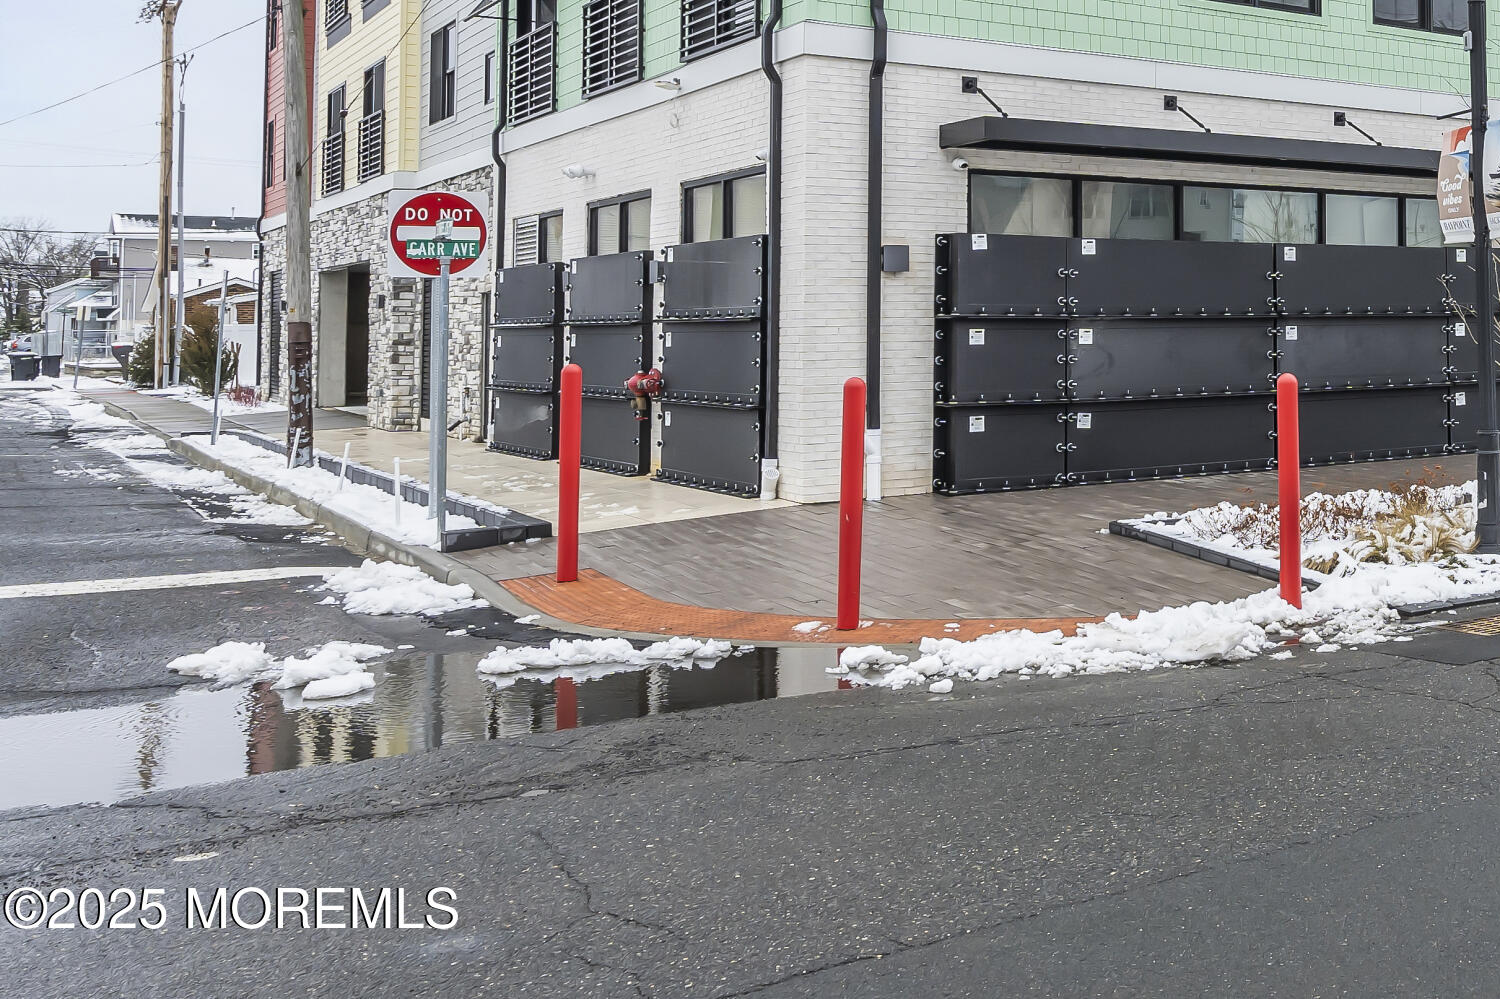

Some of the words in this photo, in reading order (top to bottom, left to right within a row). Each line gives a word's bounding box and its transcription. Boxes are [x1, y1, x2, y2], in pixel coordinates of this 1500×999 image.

[1440, 174, 1466, 193] Good
[1443, 193, 1463, 207] vibes
[405, 207, 428, 221] DO
[440, 208, 473, 222] NOT
[409, 241, 446, 256] CARR
[452, 242, 476, 257] AVE
